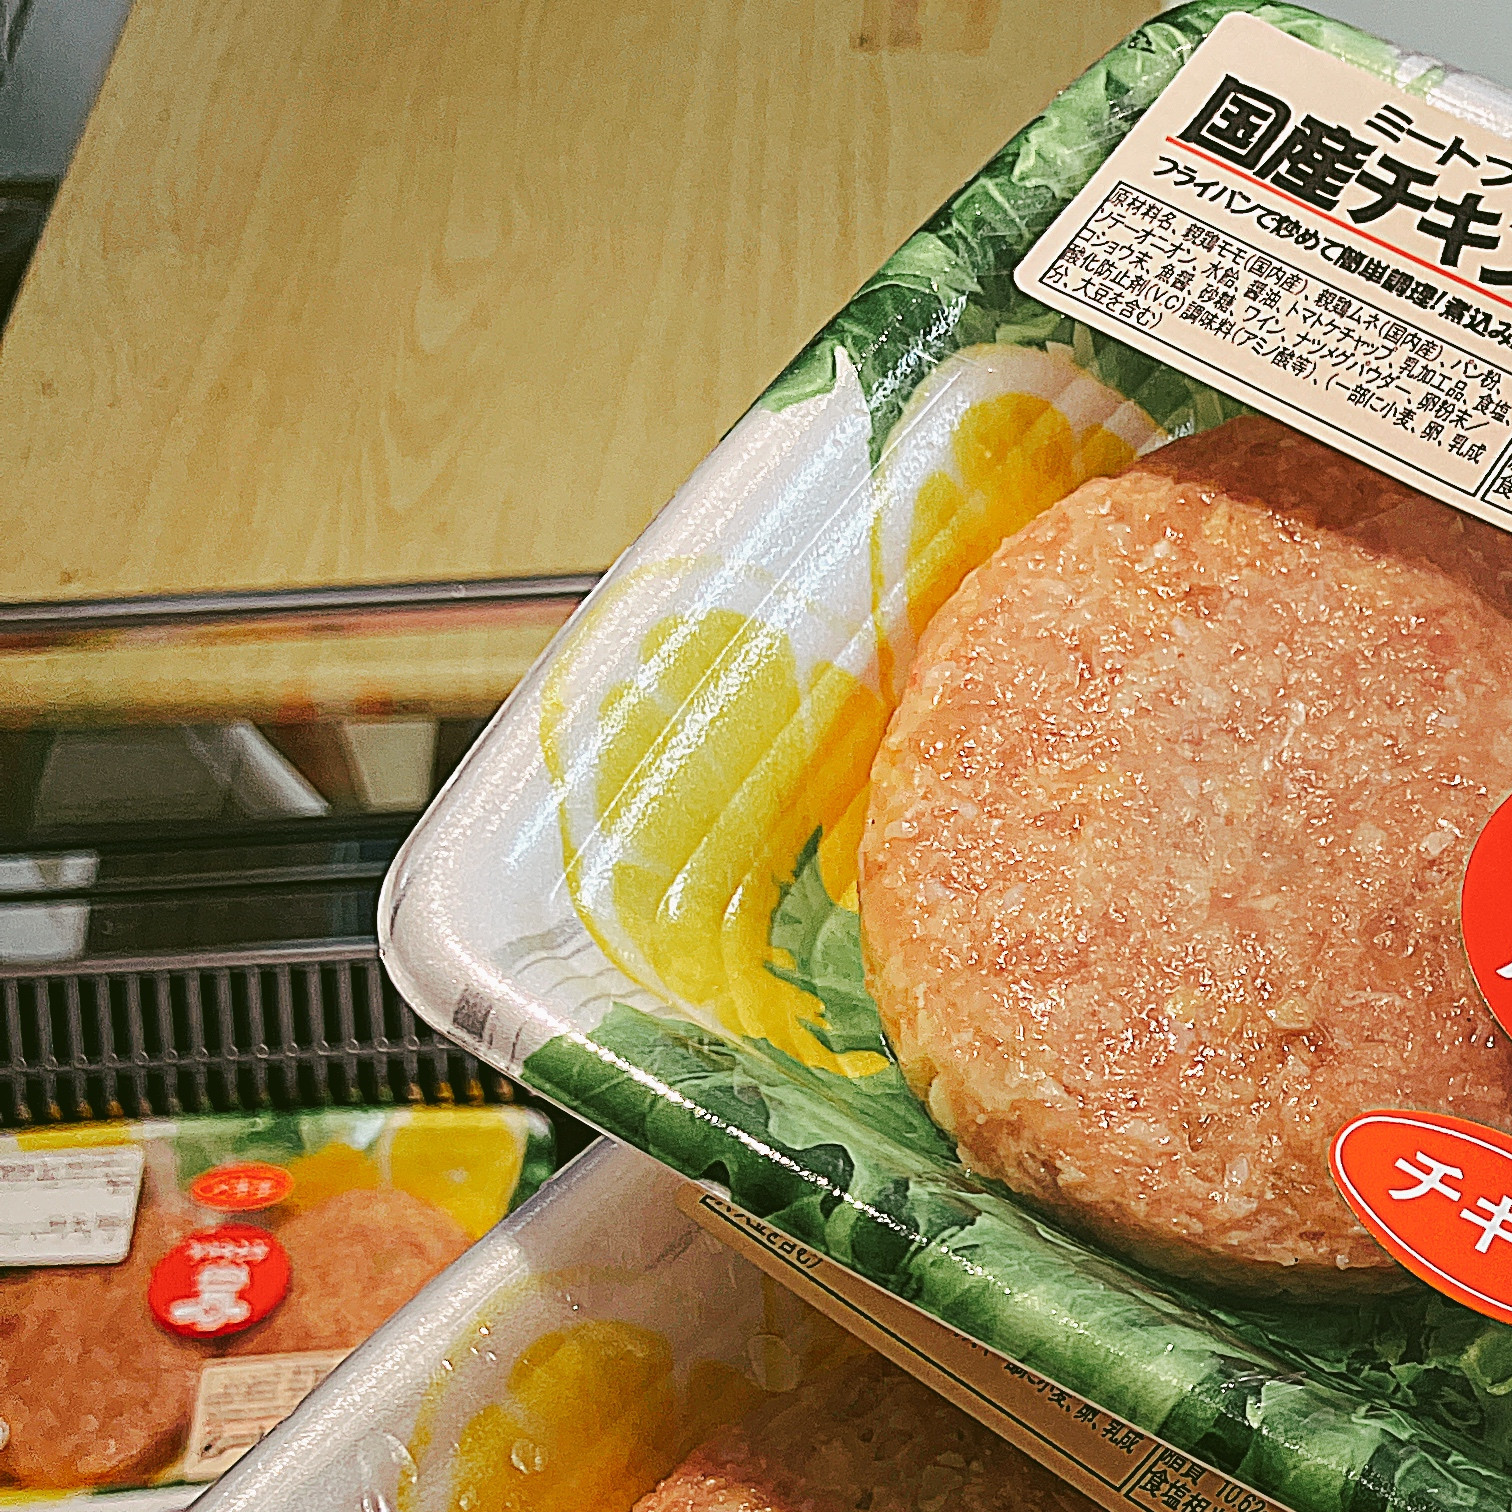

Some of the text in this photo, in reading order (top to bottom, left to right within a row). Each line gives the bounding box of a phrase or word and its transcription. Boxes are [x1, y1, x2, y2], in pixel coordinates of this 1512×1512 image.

[1046, 264, 1163, 330] 分、大豆を含む)
